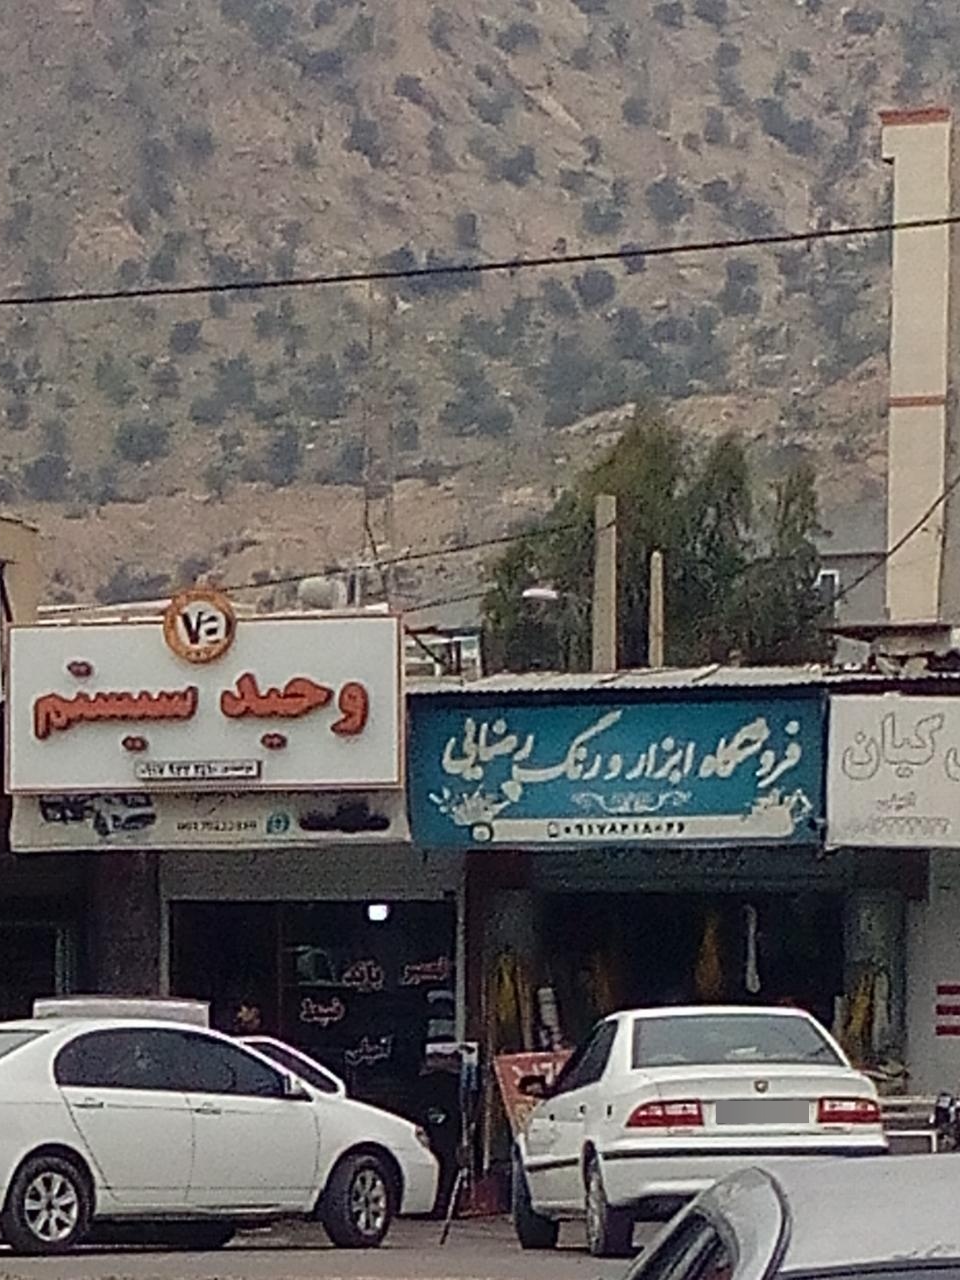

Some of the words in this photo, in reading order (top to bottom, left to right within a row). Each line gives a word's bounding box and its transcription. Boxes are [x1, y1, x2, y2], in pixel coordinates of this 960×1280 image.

[33, 660, 199, 752] سیستم
[220, 672, 370, 751] وحید
[603, 752, 623, 781] و
[626, 737, 695, 785] ابزار
[697, 716, 803, 788] فروشگاه
[841, 711, 945, 781] کیان
